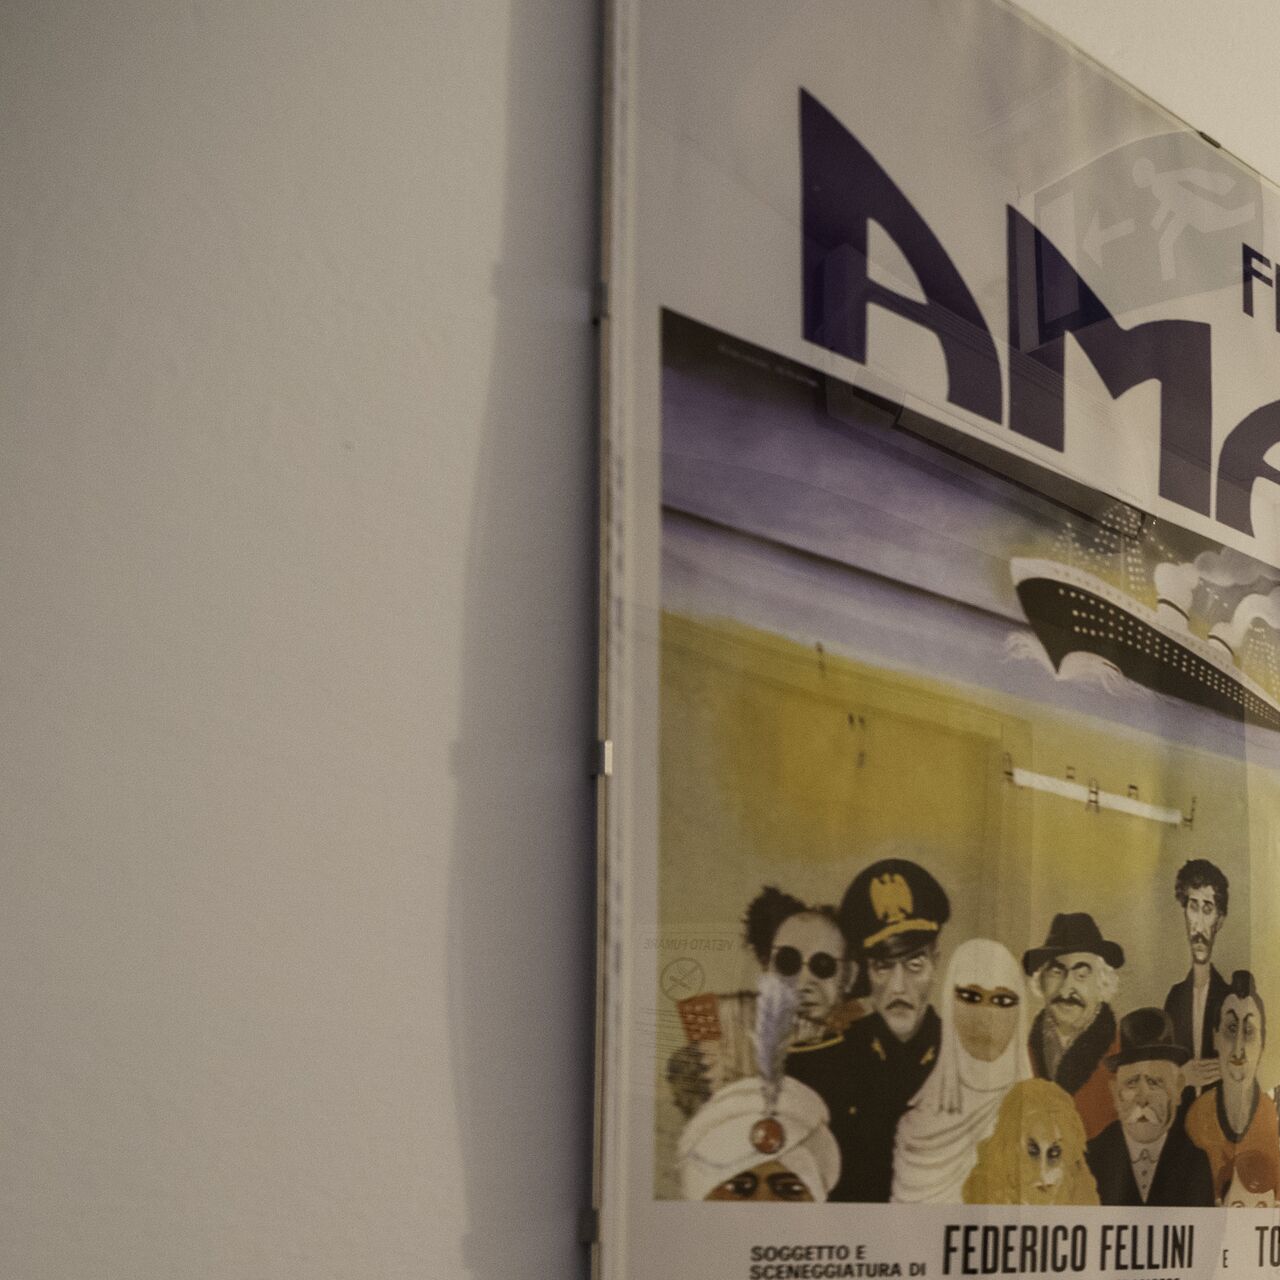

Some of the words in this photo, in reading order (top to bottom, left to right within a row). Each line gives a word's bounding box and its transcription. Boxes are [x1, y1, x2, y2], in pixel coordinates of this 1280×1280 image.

[750, 1245, 850, 1263] SOGGETTO
[855, 1244, 866, 1261] E
[942, 1224, 1088, 1276] FEDERICO
[1099, 1224, 1195, 1272] FELLINI
[1222, 1248, 1229, 1269] E
[749, 1262, 901, 1280] SCENEGGIATURA
[909, 1261, 926, 1277] DI
